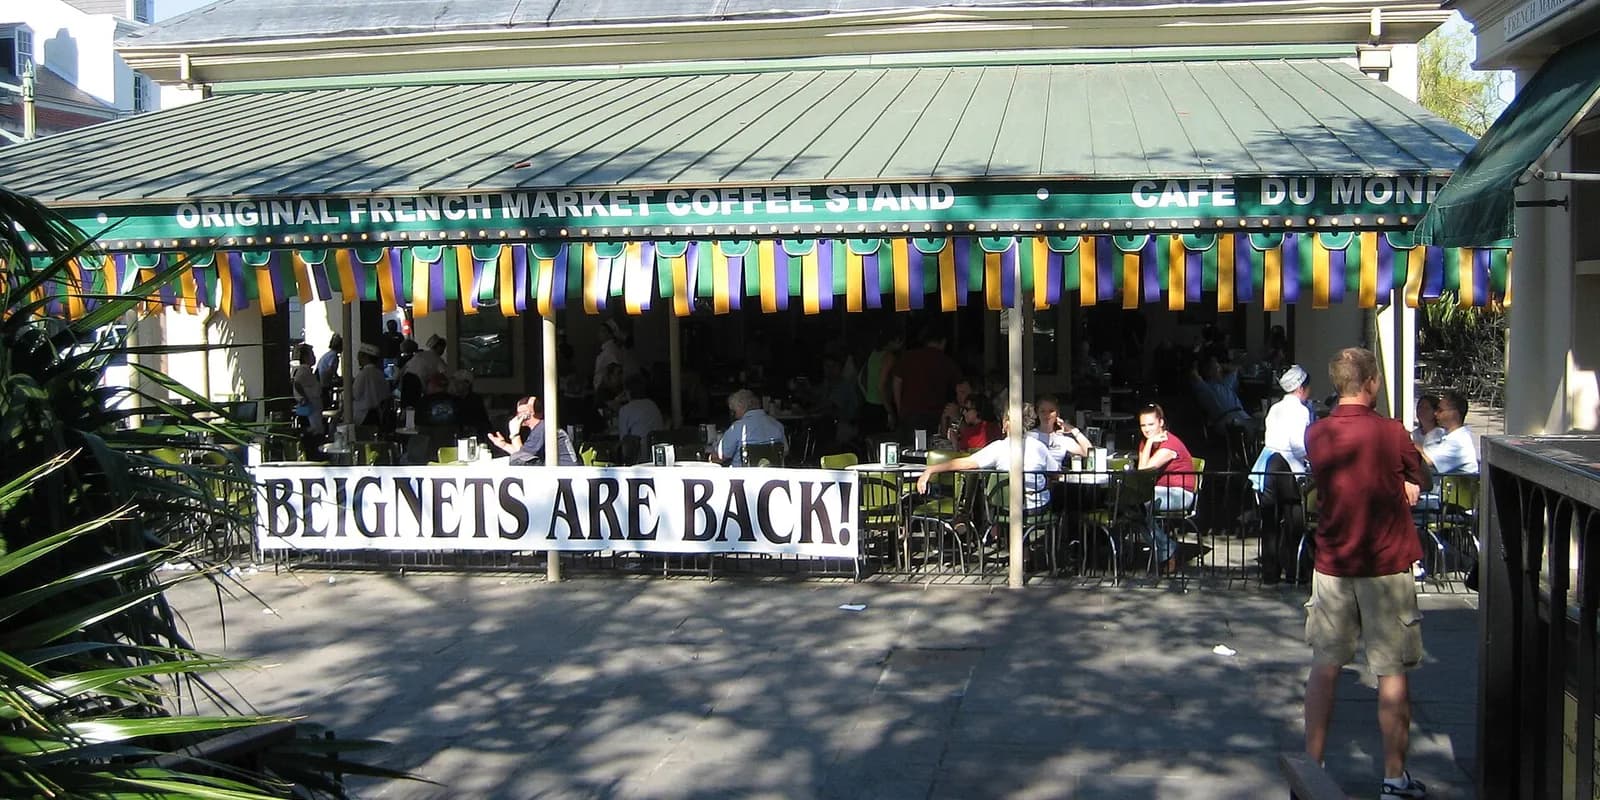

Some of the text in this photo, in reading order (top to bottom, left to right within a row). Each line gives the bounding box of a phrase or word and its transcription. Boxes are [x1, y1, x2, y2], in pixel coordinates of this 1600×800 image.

[176, 183, 956, 228] ORIGINAL FRENCH MARKET COFFEE STAND
[1131, 179, 1236, 208] CAFE
[1260, 178, 1316, 206] DU
[264, 475, 854, 546] BEIGNETS ARE BACK!
